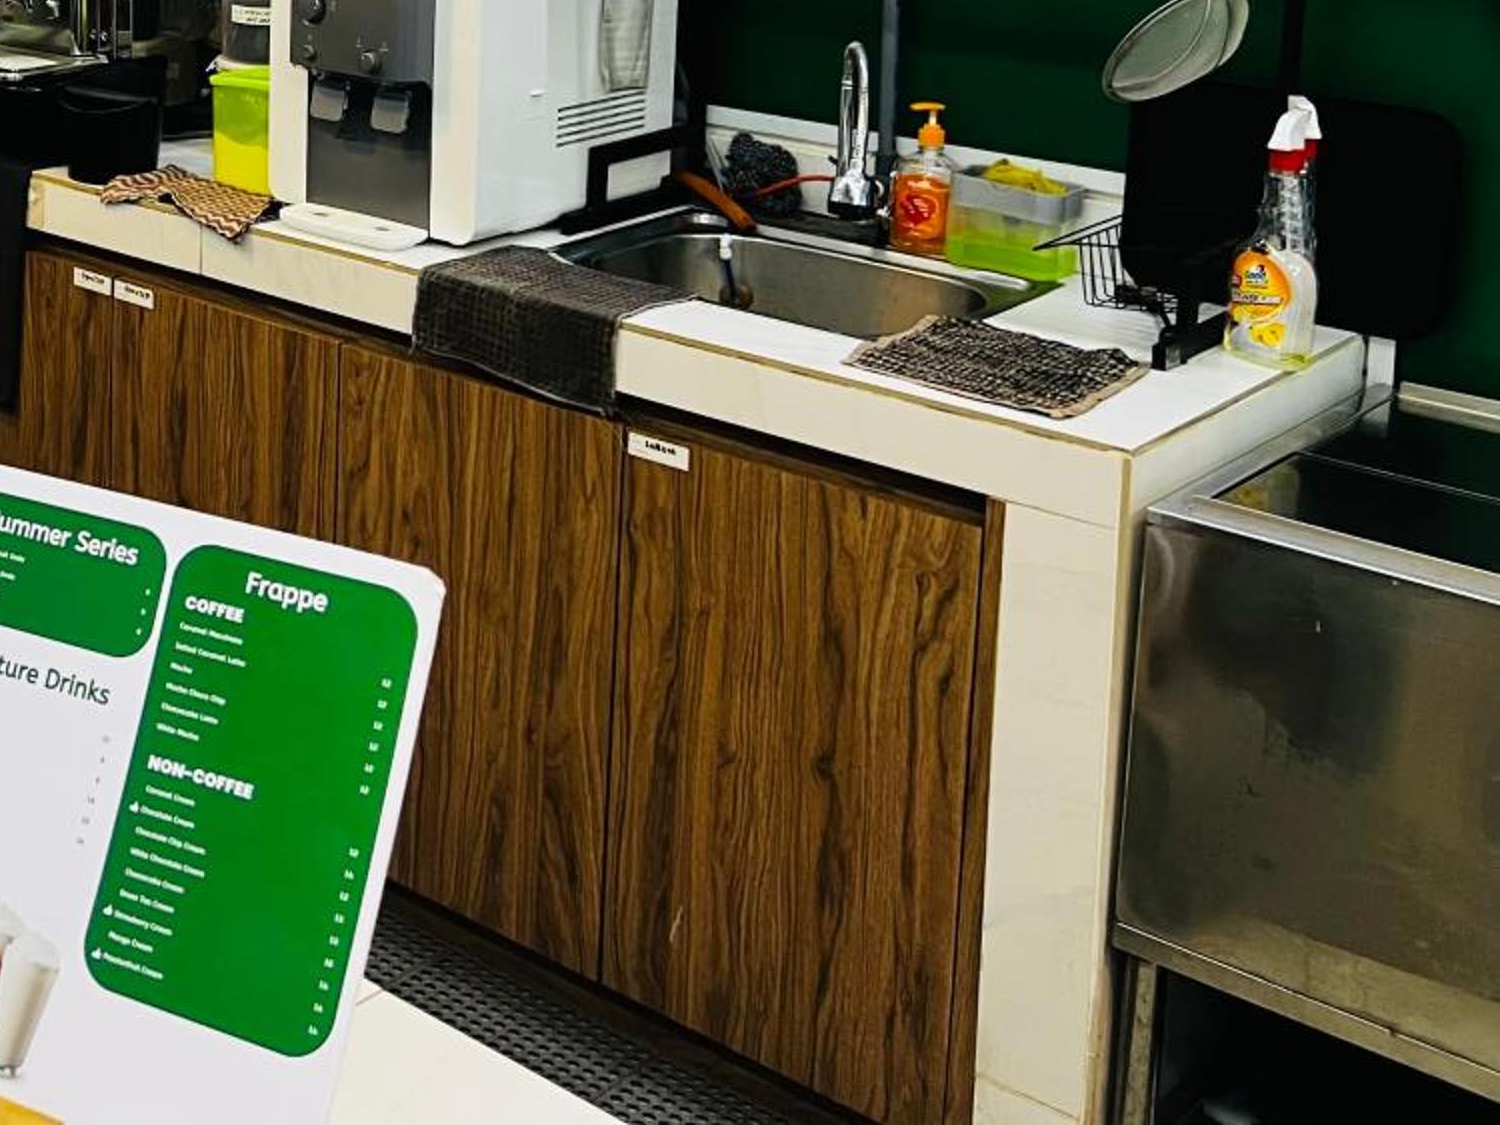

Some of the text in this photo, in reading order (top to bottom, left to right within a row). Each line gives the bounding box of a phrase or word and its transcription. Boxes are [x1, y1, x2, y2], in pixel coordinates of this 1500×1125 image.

[74, 530, 140, 565] Series
[185, 596, 245, 624] COFFEE
[244, 571, 329, 613] Frappe
[45, 667, 111, 705] Drinks
[147, 754, 255, 800] NON-COFFEE
